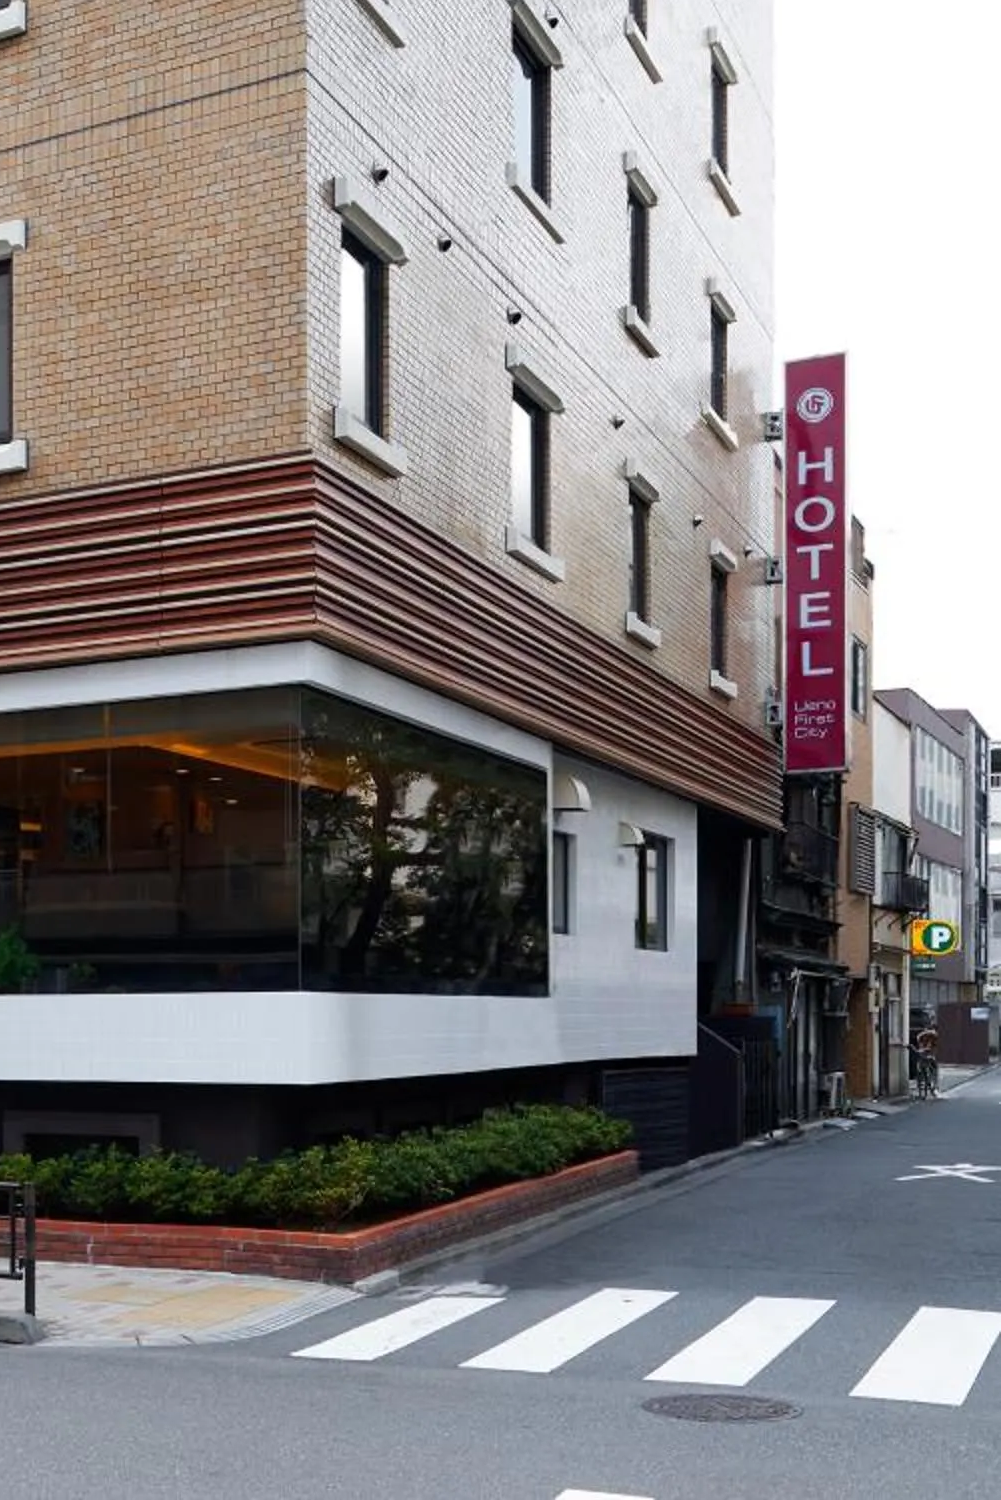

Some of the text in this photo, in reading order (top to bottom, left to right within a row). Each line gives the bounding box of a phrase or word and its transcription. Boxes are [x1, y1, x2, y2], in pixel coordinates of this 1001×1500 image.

[794, 446, 836, 677] HOTEL
[794, 713, 835, 726] First
[794, 727, 828, 739] City
[930, 926, 952, 949] P
